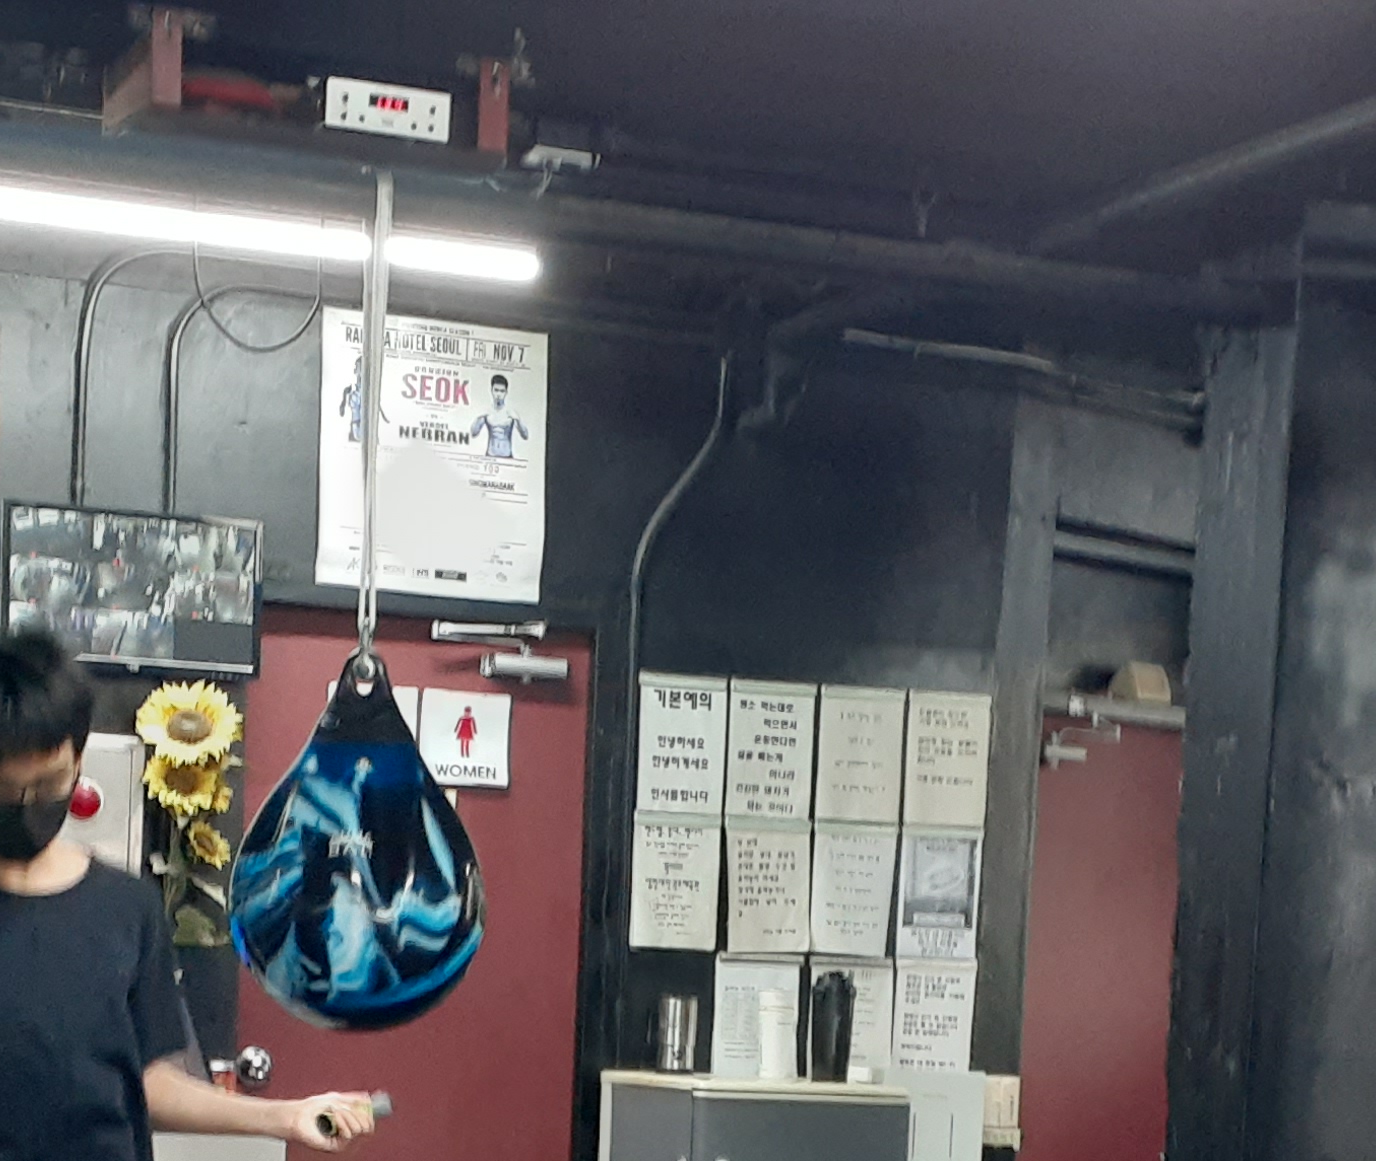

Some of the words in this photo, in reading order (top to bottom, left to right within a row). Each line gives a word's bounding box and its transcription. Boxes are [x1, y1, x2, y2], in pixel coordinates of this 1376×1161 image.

[430, 336, 462, 356] SEOUL
[493, 343, 514, 362] NOV
[518, 347, 525, 363] 7
[400, 373, 470, 406] SEOK
[654, 689, 712, 711] 기본예의
[657, 735, 705, 750] 안녕하세요
[435, 763, 497, 780] WOMEN
